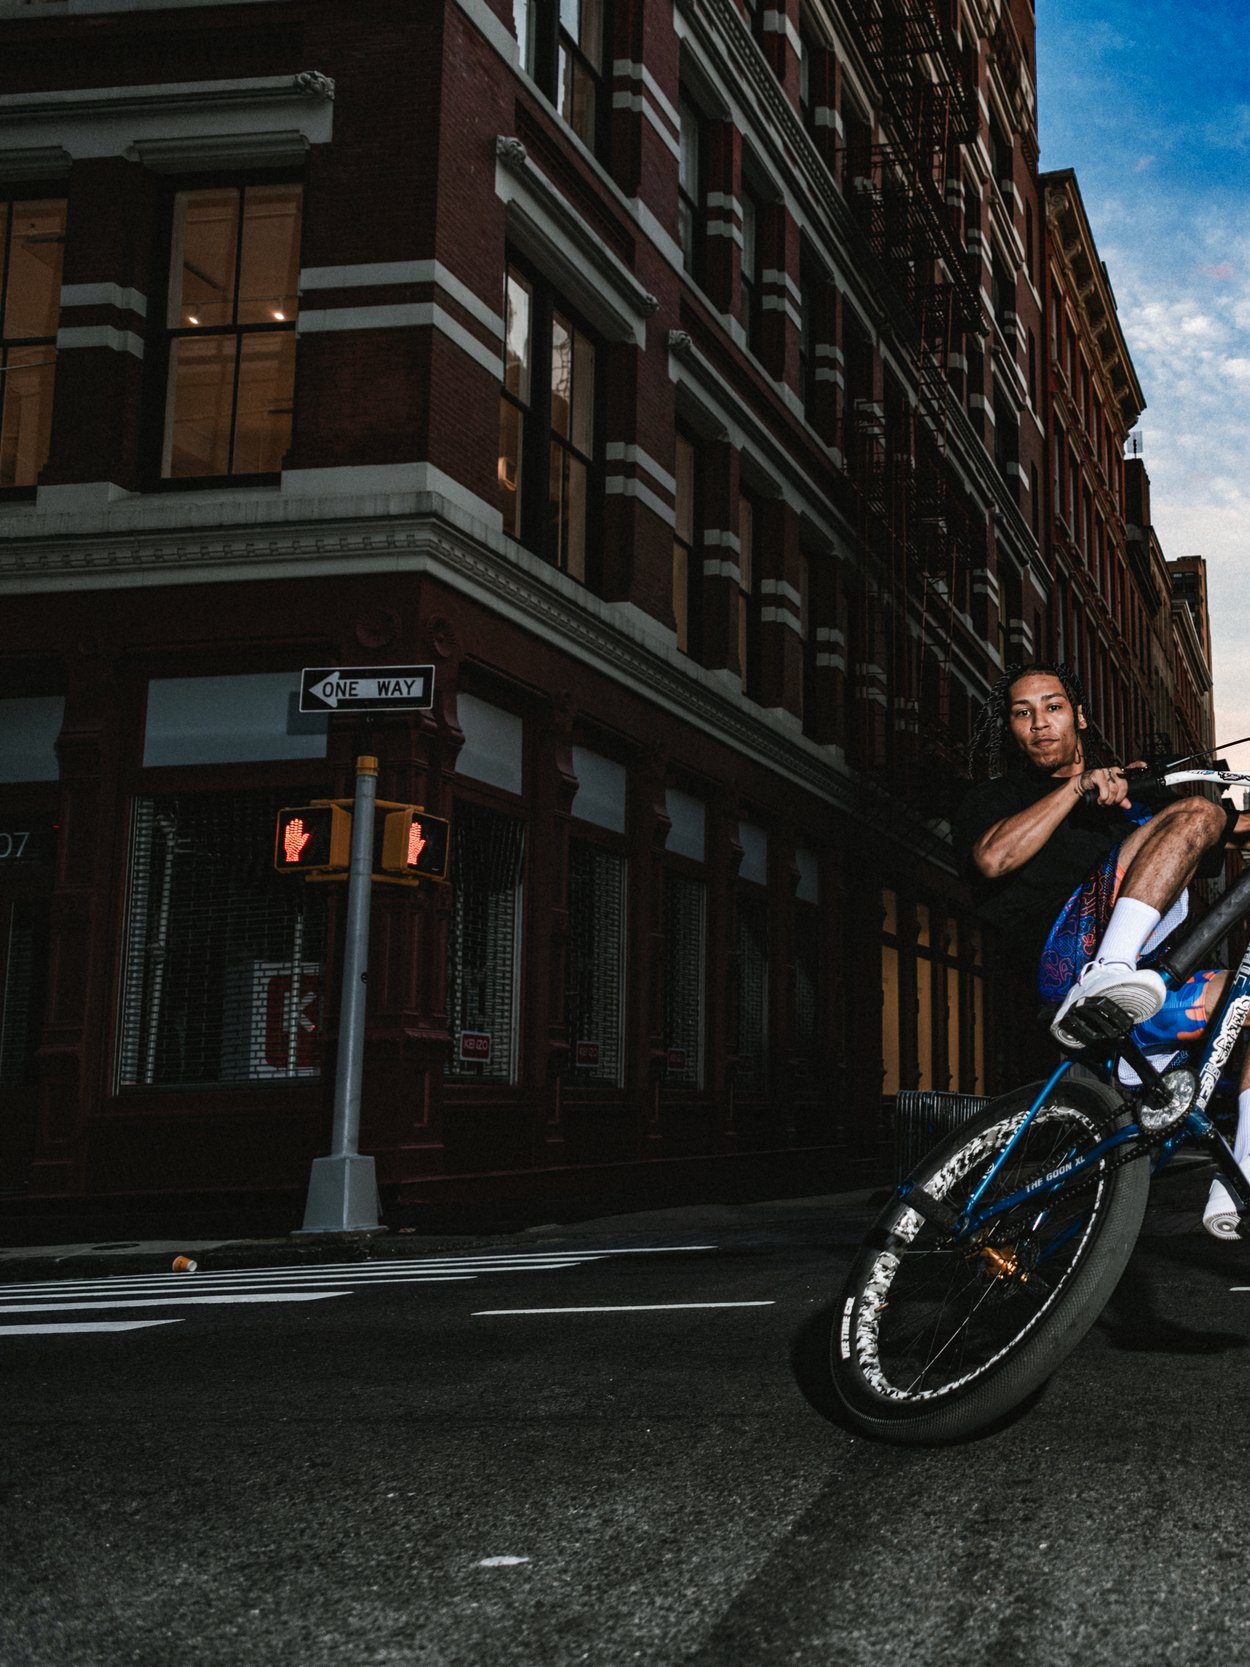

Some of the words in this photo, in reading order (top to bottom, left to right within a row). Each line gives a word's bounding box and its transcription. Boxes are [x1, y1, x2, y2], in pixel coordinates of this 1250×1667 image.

[322, 681, 359, 698] ONE
[377, 679, 416, 697] WAY
[1025, 1177, 1043, 1193] THE
[1046, 1162, 1072, 1181] GOON
[1075, 1155, 1086, 1167] XL
